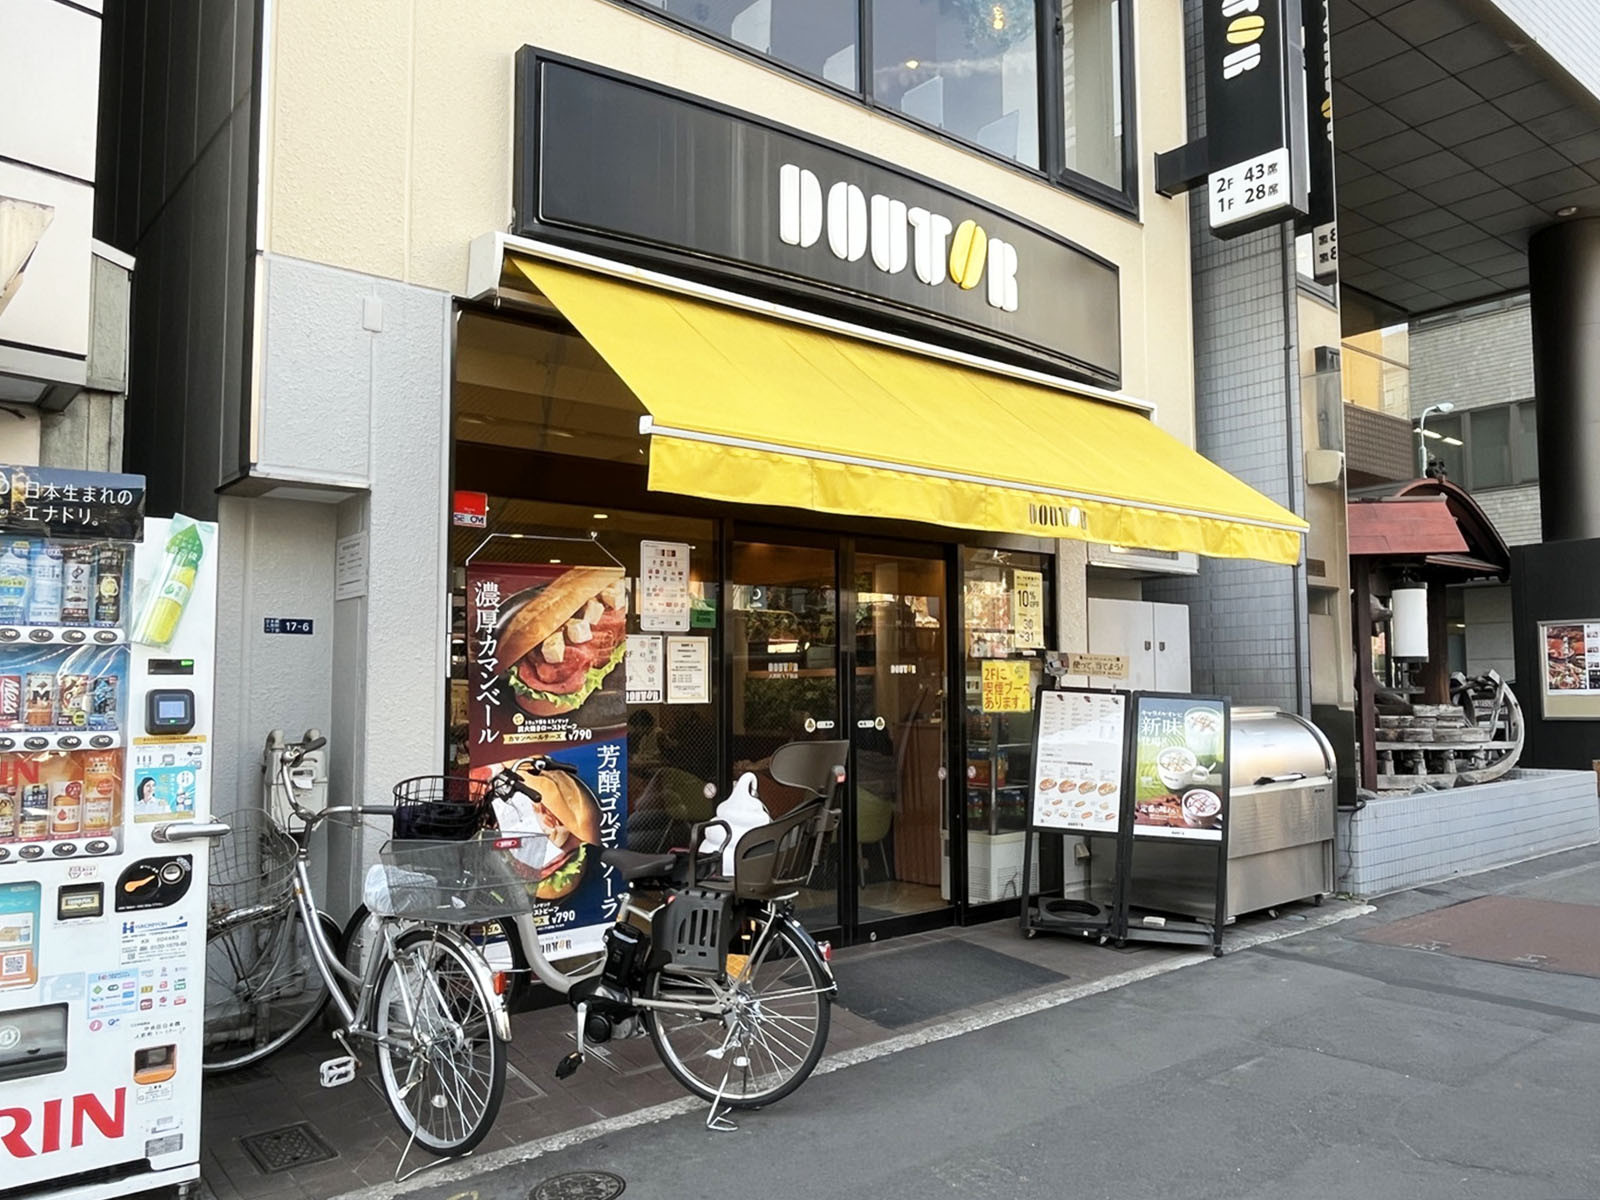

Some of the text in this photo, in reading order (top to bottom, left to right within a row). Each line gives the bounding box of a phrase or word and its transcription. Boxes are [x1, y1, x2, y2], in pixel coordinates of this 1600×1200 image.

[1217, 178, 1234, 193] 2F
[1218, 198, 1234, 212] 1F
[780, 164, 1018, 312] DOUTOR
[25, 481, 133, 505] 日本生まれの
[24, 505, 99, 526] エナドリ。
[453, 513, 485, 524] SEOM
[1018, 590, 1029, 607] 10
[285, 621, 310, 632] 17-6
[474, 581, 501, 745] 濃厚カマンベール
[568, 729, 592, 741] ¥790
[551, 910, 576, 924] ¥790
[0, 1087, 126, 1158] RIN
